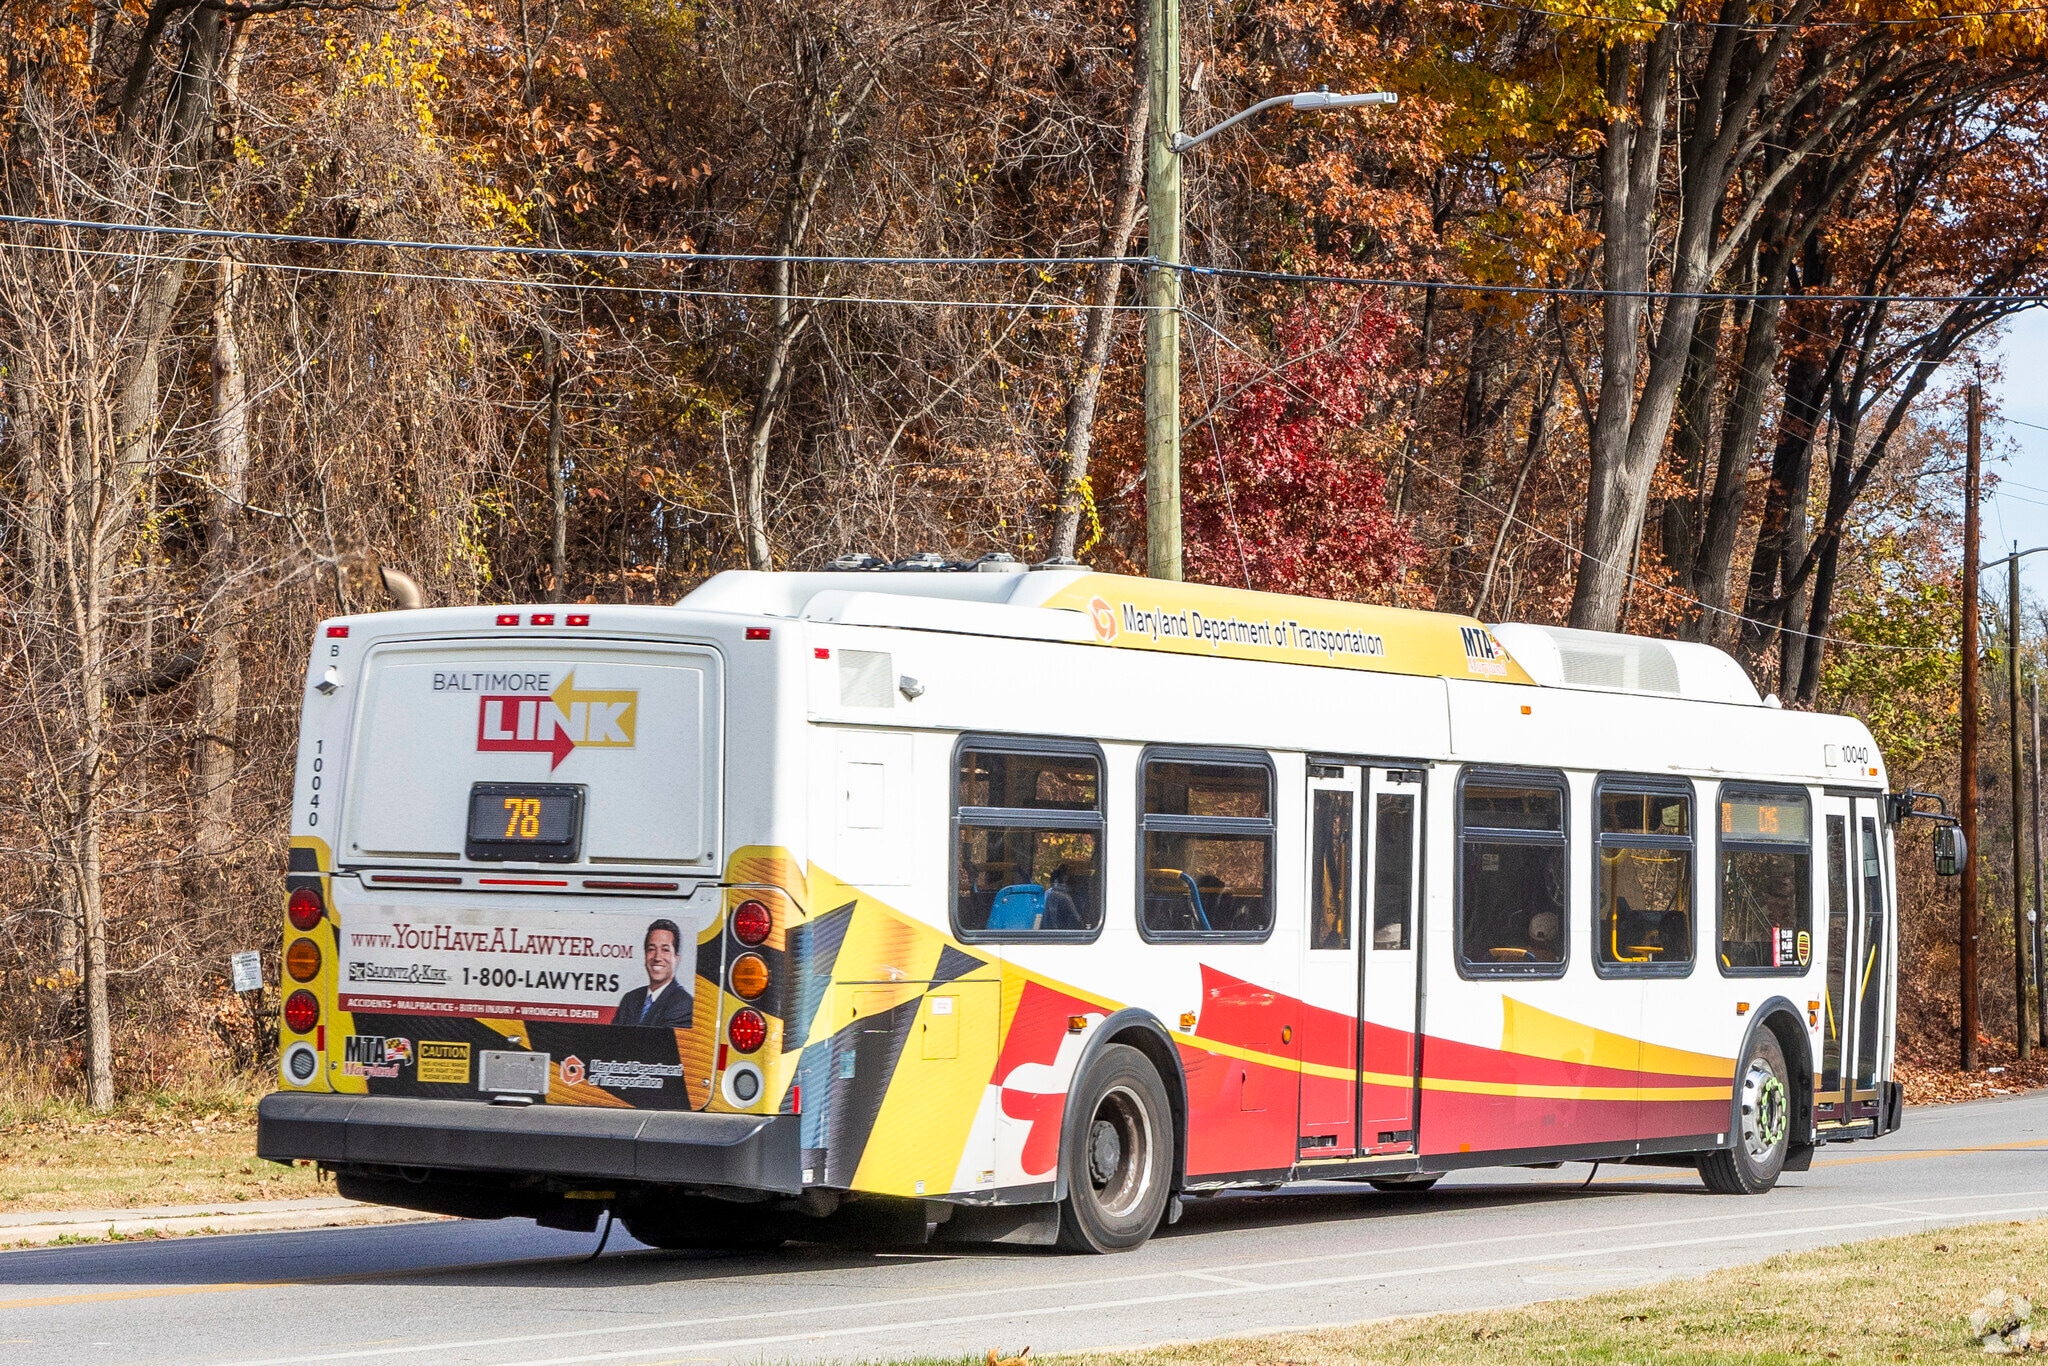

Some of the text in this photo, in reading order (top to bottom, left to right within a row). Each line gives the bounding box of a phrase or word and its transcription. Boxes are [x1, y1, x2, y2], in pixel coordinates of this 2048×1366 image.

[1122, 603, 1384, 657] Maryland Department of Transportation
[330, 644, 340, 657] B
[1460, 626, 1495, 660] MTA
[432, 673, 551, 692] BALTIMORE
[482, 700, 632, 743] LINK
[1841, 745, 1869, 765] 10040
[503, 798, 542, 839] 78
[462, 967, 620, 993] 1-800-LAWYERS
[347, 998, 599, 1019] ACCIDENTS MALPRACTICE BIRTH INJURY WRONGFUL DEATH
[344, 1035, 387, 1065] MTA
[421, 1045, 468, 1058] CAUTION
[342, 1061, 400, 1080] Maryland
[590, 1059, 683, 1076] Maryland Department
[588, 1073, 664, 1090] of Transportation
